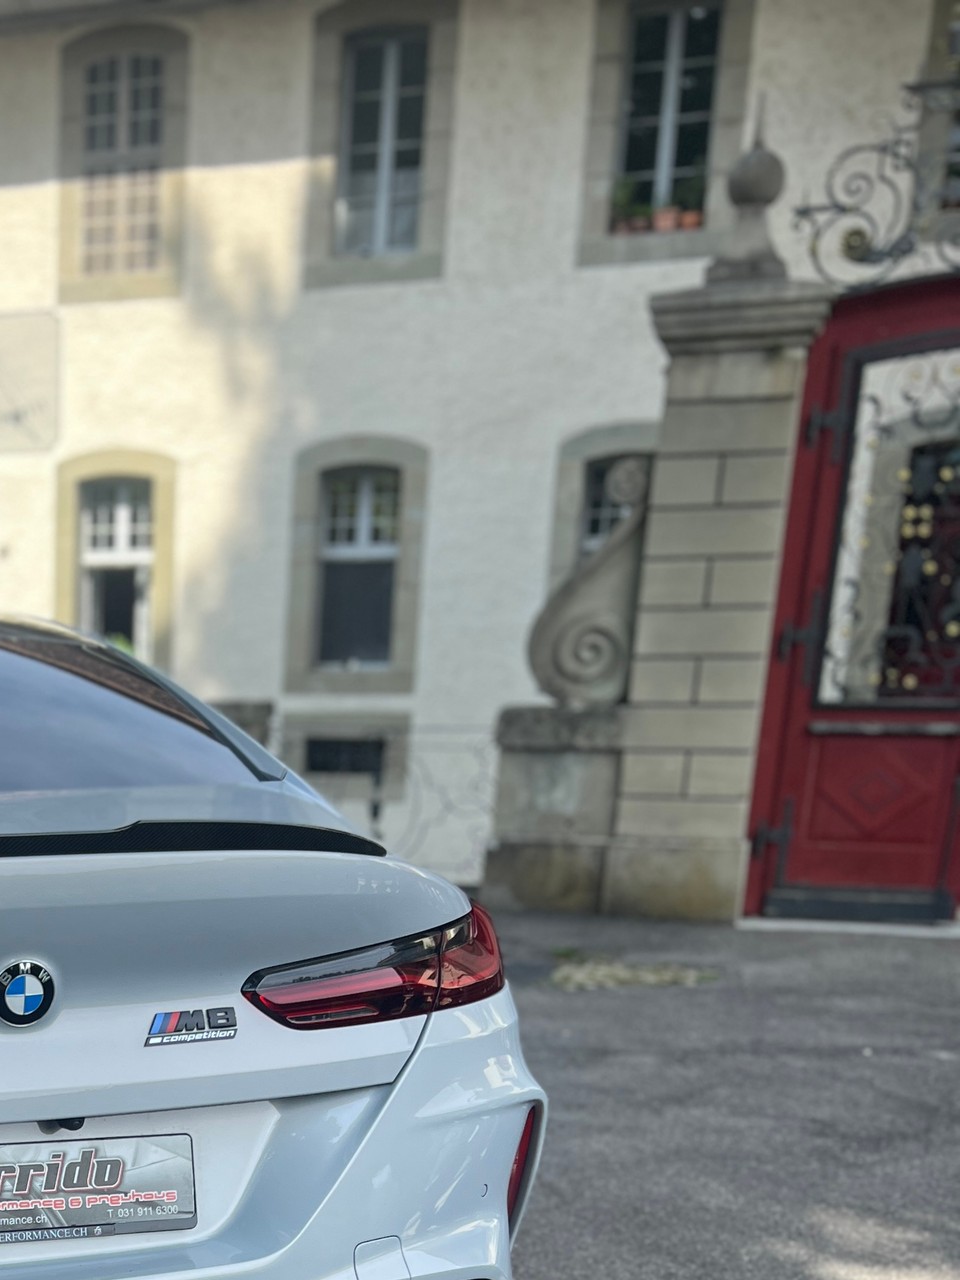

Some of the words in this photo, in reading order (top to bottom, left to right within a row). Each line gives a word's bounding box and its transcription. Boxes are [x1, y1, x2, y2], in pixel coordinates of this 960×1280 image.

[0, 962, 51, 986] BMW
[162, 1030, 235, 1043] competition
[86, 1189, 177, 1208] pneuhaus
[117, 1208, 134, 1218] 031
[137, 1206, 153, 1217] 911
[155, 1204, 179, 1215] 6300
